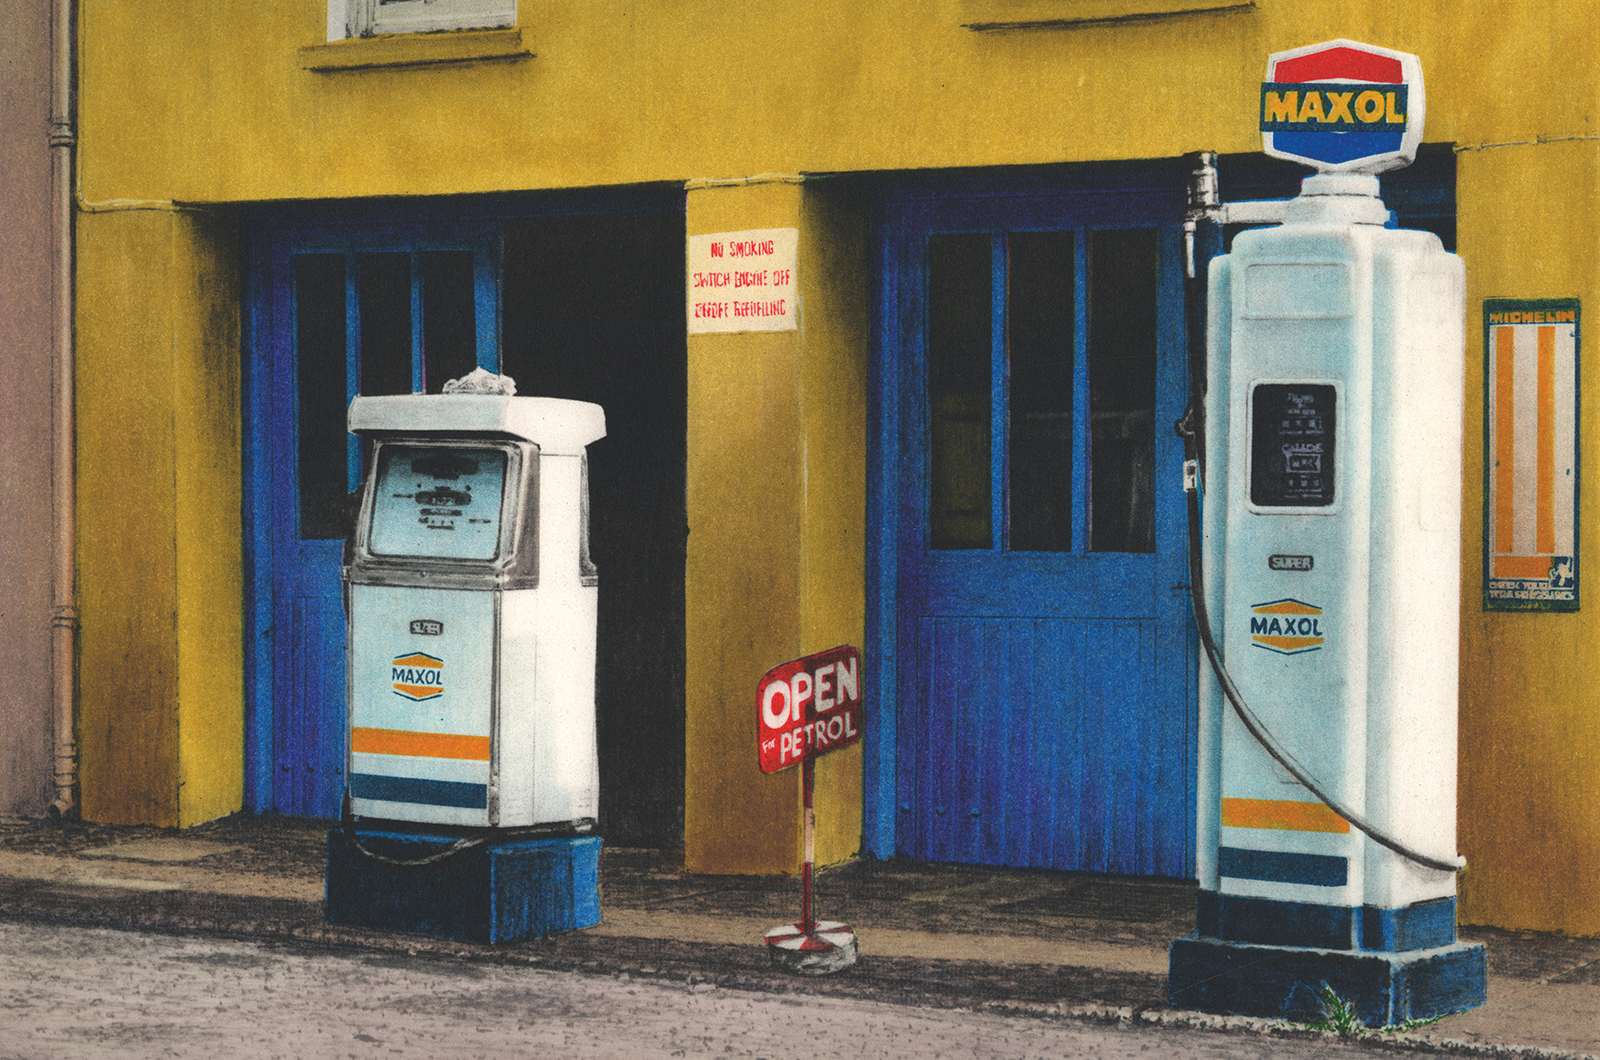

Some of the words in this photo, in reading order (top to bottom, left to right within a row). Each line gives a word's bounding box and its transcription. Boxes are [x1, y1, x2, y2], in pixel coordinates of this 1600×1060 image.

[1265, 90, 1406, 123] MAXOL
[710, 241, 724, 258] NO
[729, 240, 774, 258] SMOKING
[693, 272, 731, 288] SWITCH
[734, 270, 768, 288] ENGINE
[773, 269, 790, 287] OFF
[1489, 310, 1575, 323] MICHELIN
[1271, 556, 1312, 570] SUPER
[1250, 617, 1323, 636] MAXOL
[392, 667, 443, 685] MAXOL
[762, 657, 858, 729] OPEN
[781, 712, 857, 764] PETROL
